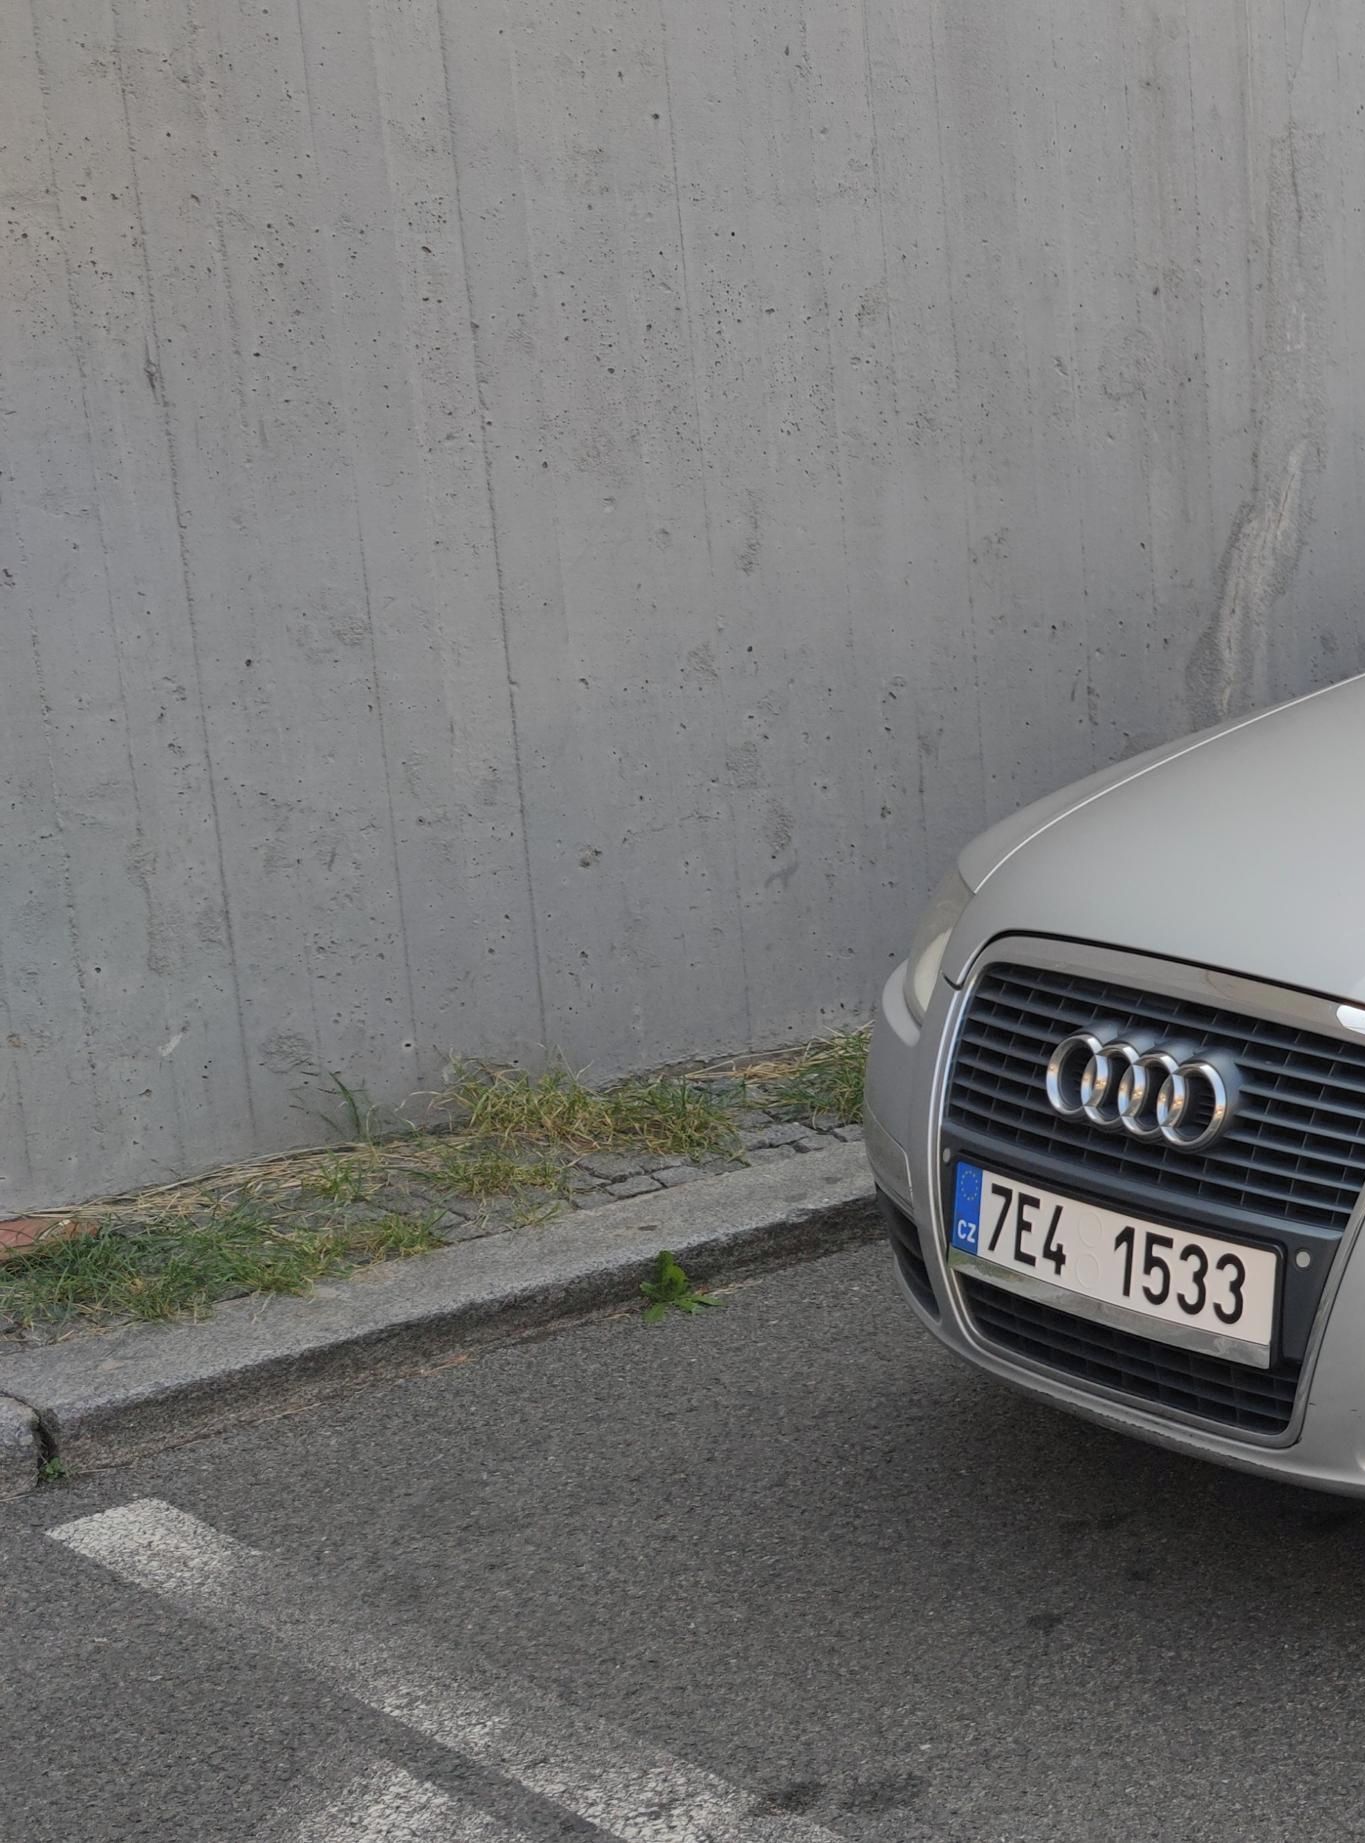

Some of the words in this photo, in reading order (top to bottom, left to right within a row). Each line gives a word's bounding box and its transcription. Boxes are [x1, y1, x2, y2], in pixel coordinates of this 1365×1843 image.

[957, 1219, 977, 1243] CZ
[988, 1182, 1066, 1275] 7E4
[1114, 1225, 1245, 1325] 1533
